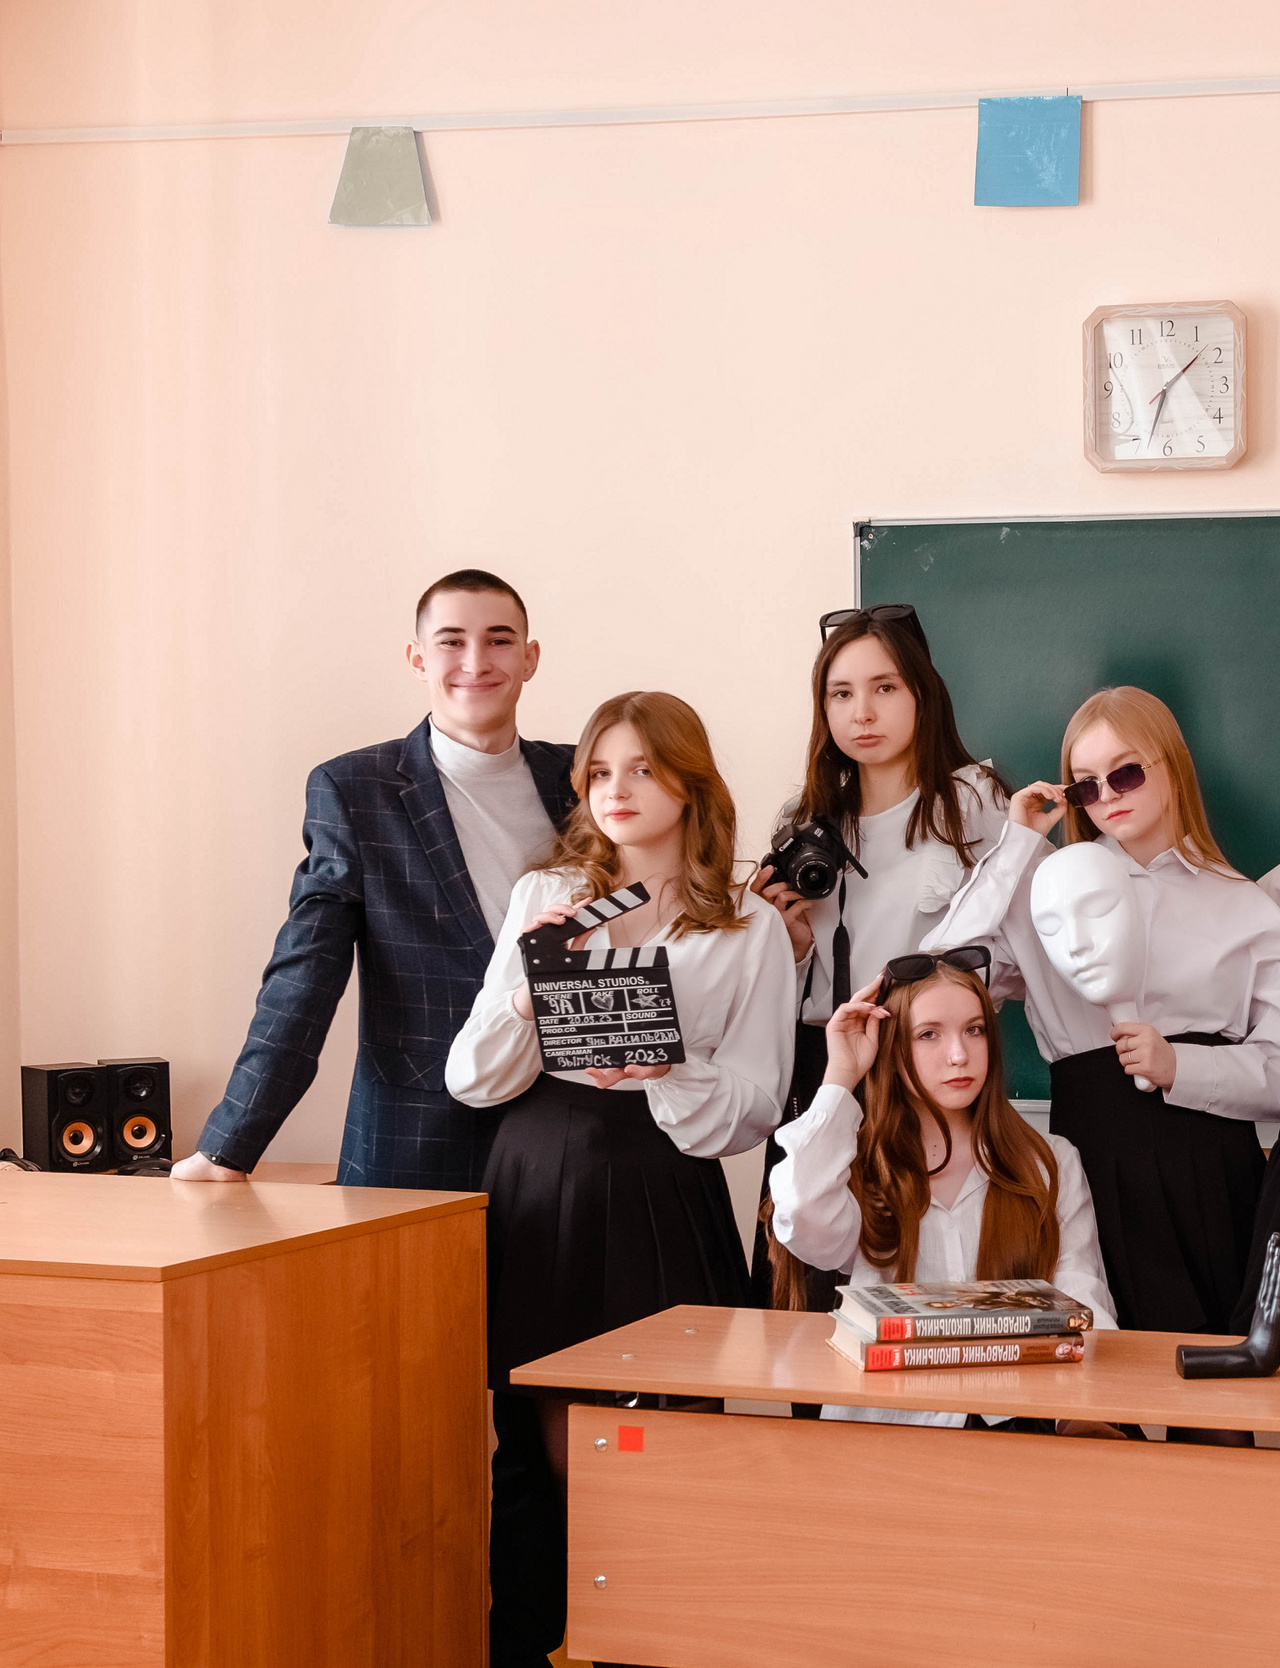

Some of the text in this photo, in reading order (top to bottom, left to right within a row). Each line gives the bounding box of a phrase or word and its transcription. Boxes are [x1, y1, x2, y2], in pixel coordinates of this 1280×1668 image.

[1130, 328, 1143, 346] 11
[1159, 320, 1176, 337] 12
[1193, 325, 1200, 343] 1
[1108, 352, 1124, 369] 10
[1213, 347, 1224, 364] 2
[1103, 381, 1114, 400] 9
[1218, 376, 1230, 394] 3
[1111, 412, 1121, 429] 8
[1212, 407, 1224, 425] 4
[1131, 438, 1142, 455] 7
[1162, 439, 1173, 457] 6
[1195, 435, 1206, 453] 5
[533, 979, 596, 992] UNIVERSAL
[625, 1012, 657, 1020] SOUND
[543, 1038, 582, 1046] DIRECTOR
[545, 1048, 592, 1057] CAMERAMAN
[624, 1047, 668, 1064] 2023
[915, 1317, 972, 1337] ШКОЛЬНИКА
[973, 1315, 1031, 1335] СПРАВОЧНИК
[903, 1347, 960, 1366] ШКОЛЬНИКА
[961, 1344, 1020, 1364] СПРАВОЧНИК
